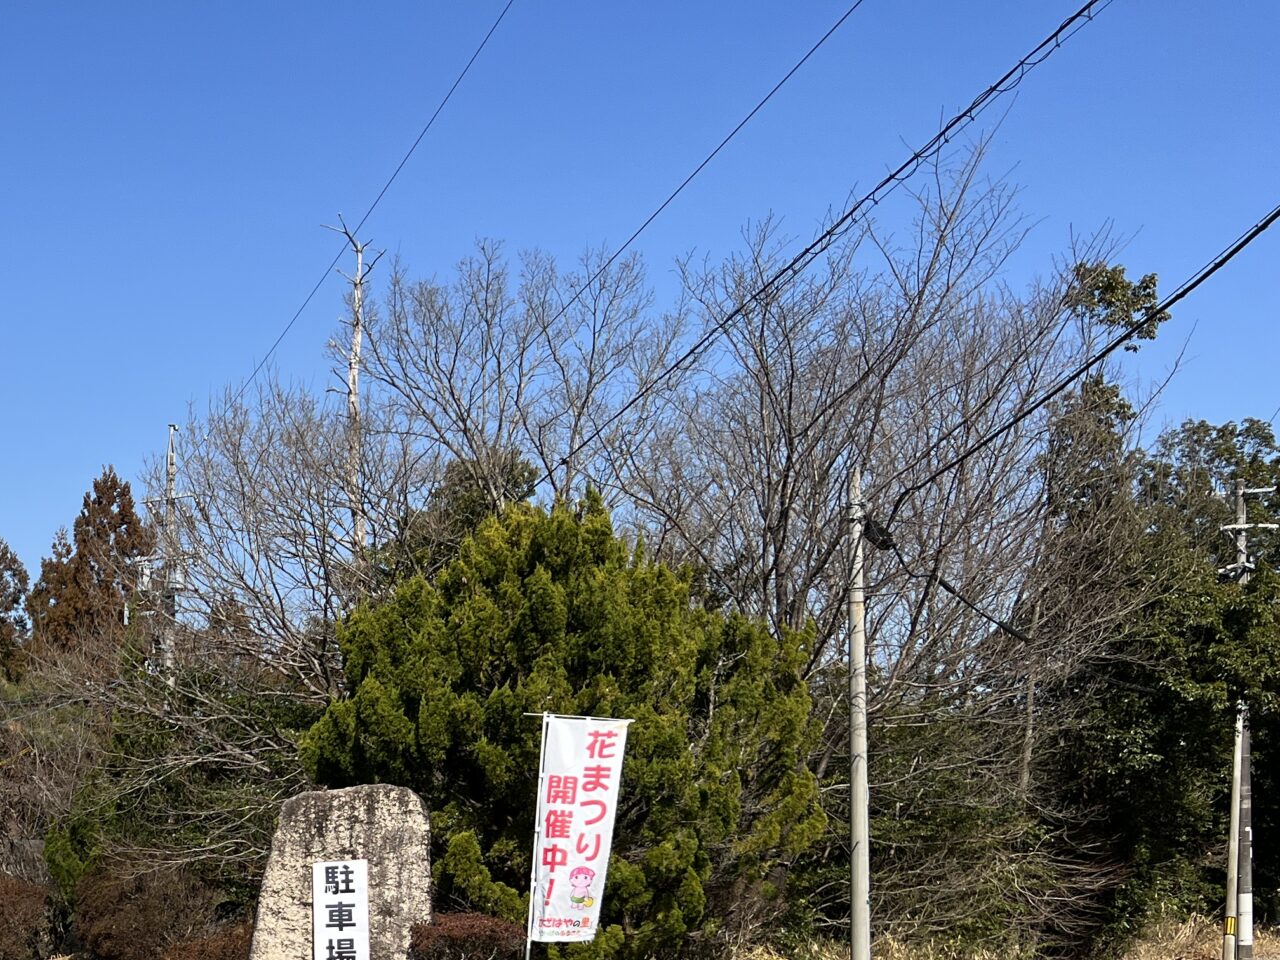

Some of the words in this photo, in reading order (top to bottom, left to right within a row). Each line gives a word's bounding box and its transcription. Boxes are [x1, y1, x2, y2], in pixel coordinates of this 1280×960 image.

[541, 774, 579, 907] 開催中！
[575, 729, 619, 863] 花まつり
